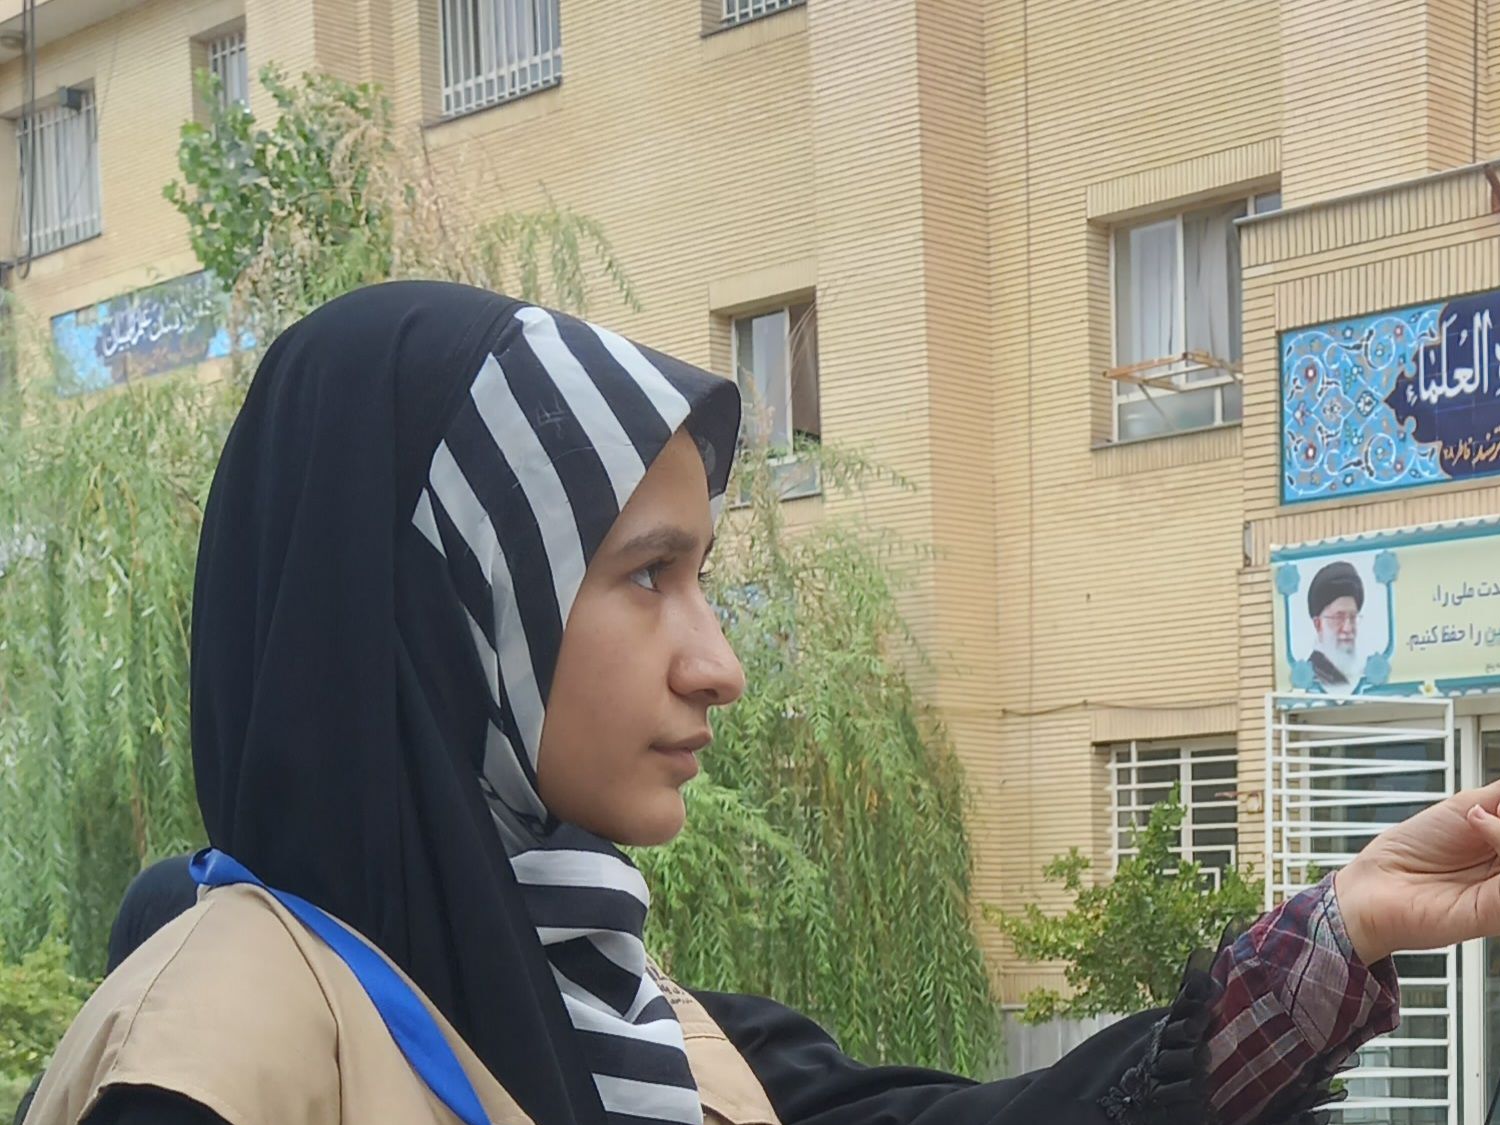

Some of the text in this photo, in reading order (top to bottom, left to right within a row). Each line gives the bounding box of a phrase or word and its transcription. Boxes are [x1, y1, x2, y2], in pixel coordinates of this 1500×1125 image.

[1451, 582, 1475, 606] ملی
[1442, 624, 1466, 643] حفظ
[1470, 623, 1482, 646] را
